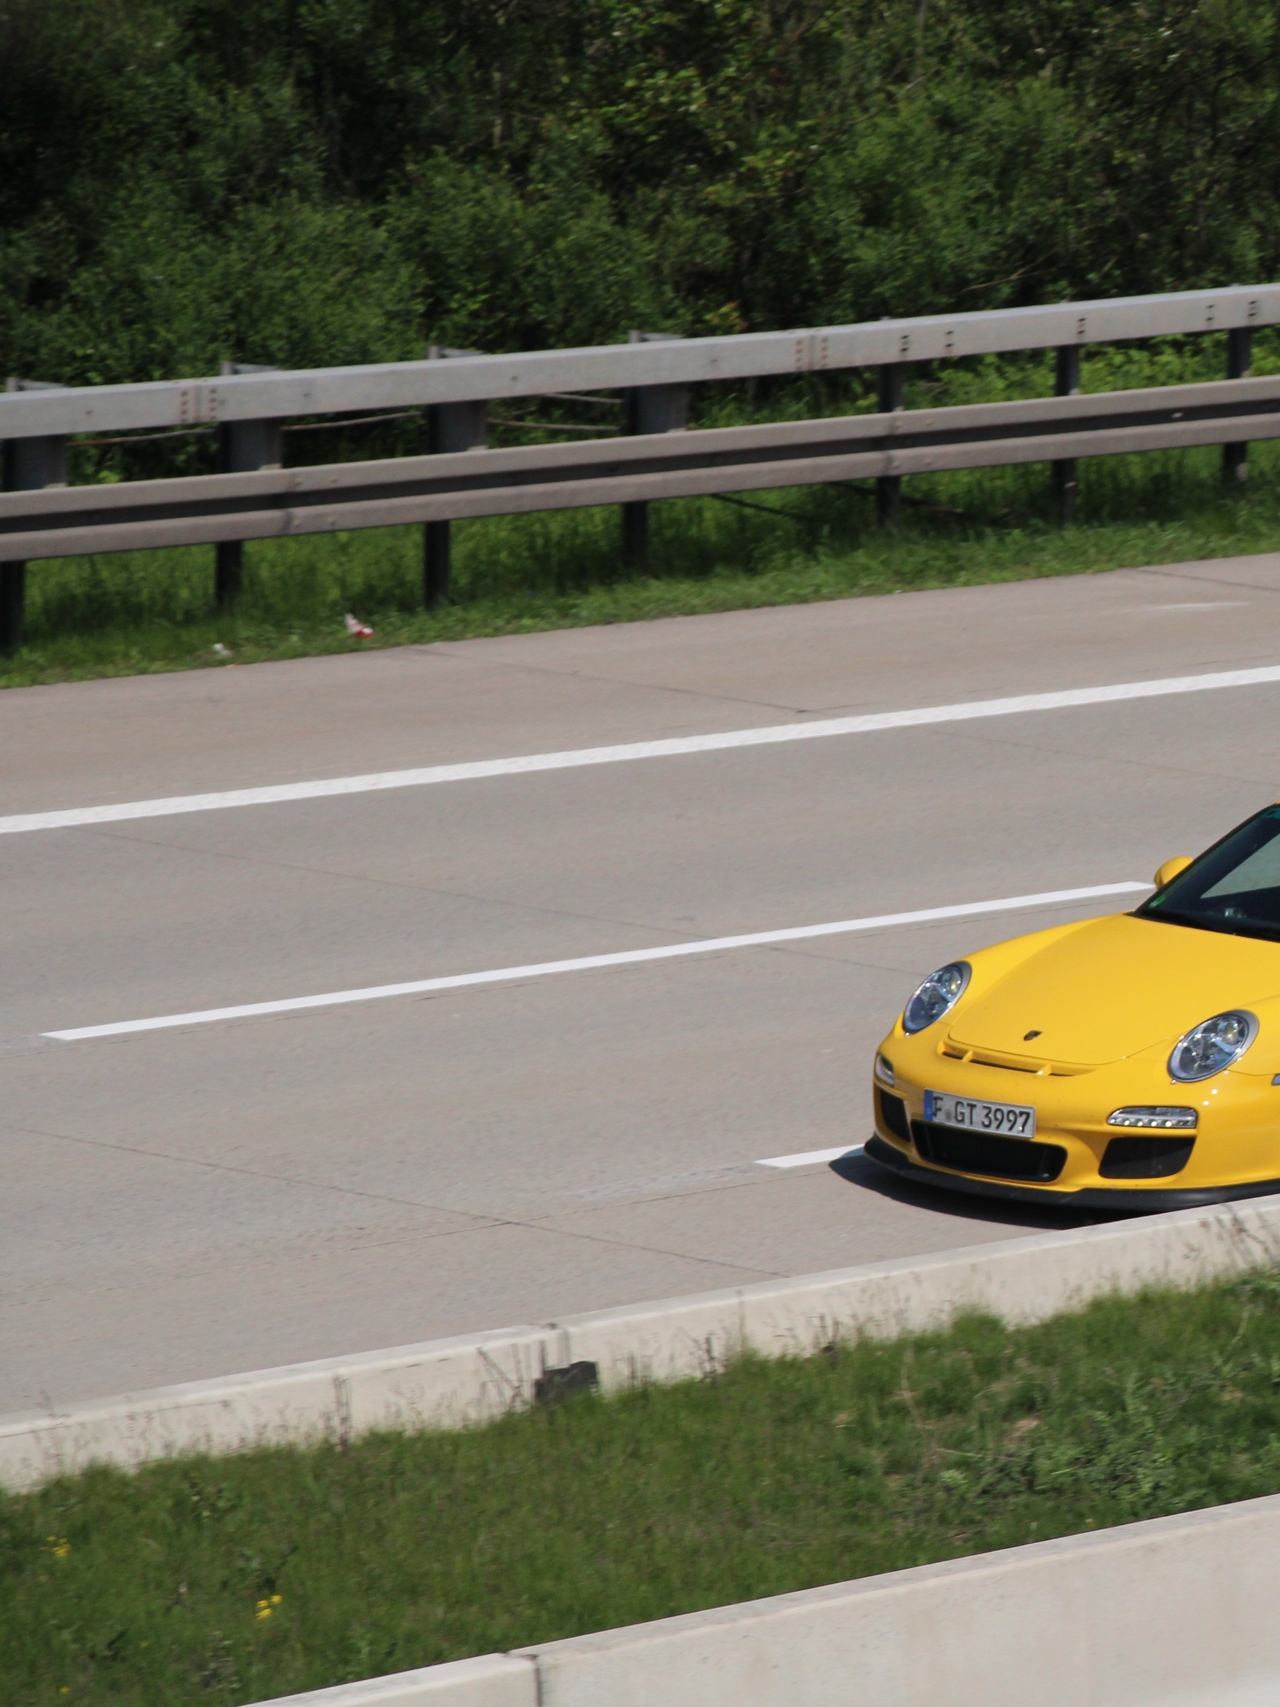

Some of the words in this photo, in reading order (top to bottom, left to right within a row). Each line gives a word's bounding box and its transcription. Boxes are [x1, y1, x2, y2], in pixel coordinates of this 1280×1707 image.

[933, 1096, 944, 1118] F
[955, 1101, 977, 1126] GT
[981, 1105, 1031, 1133] 3997
